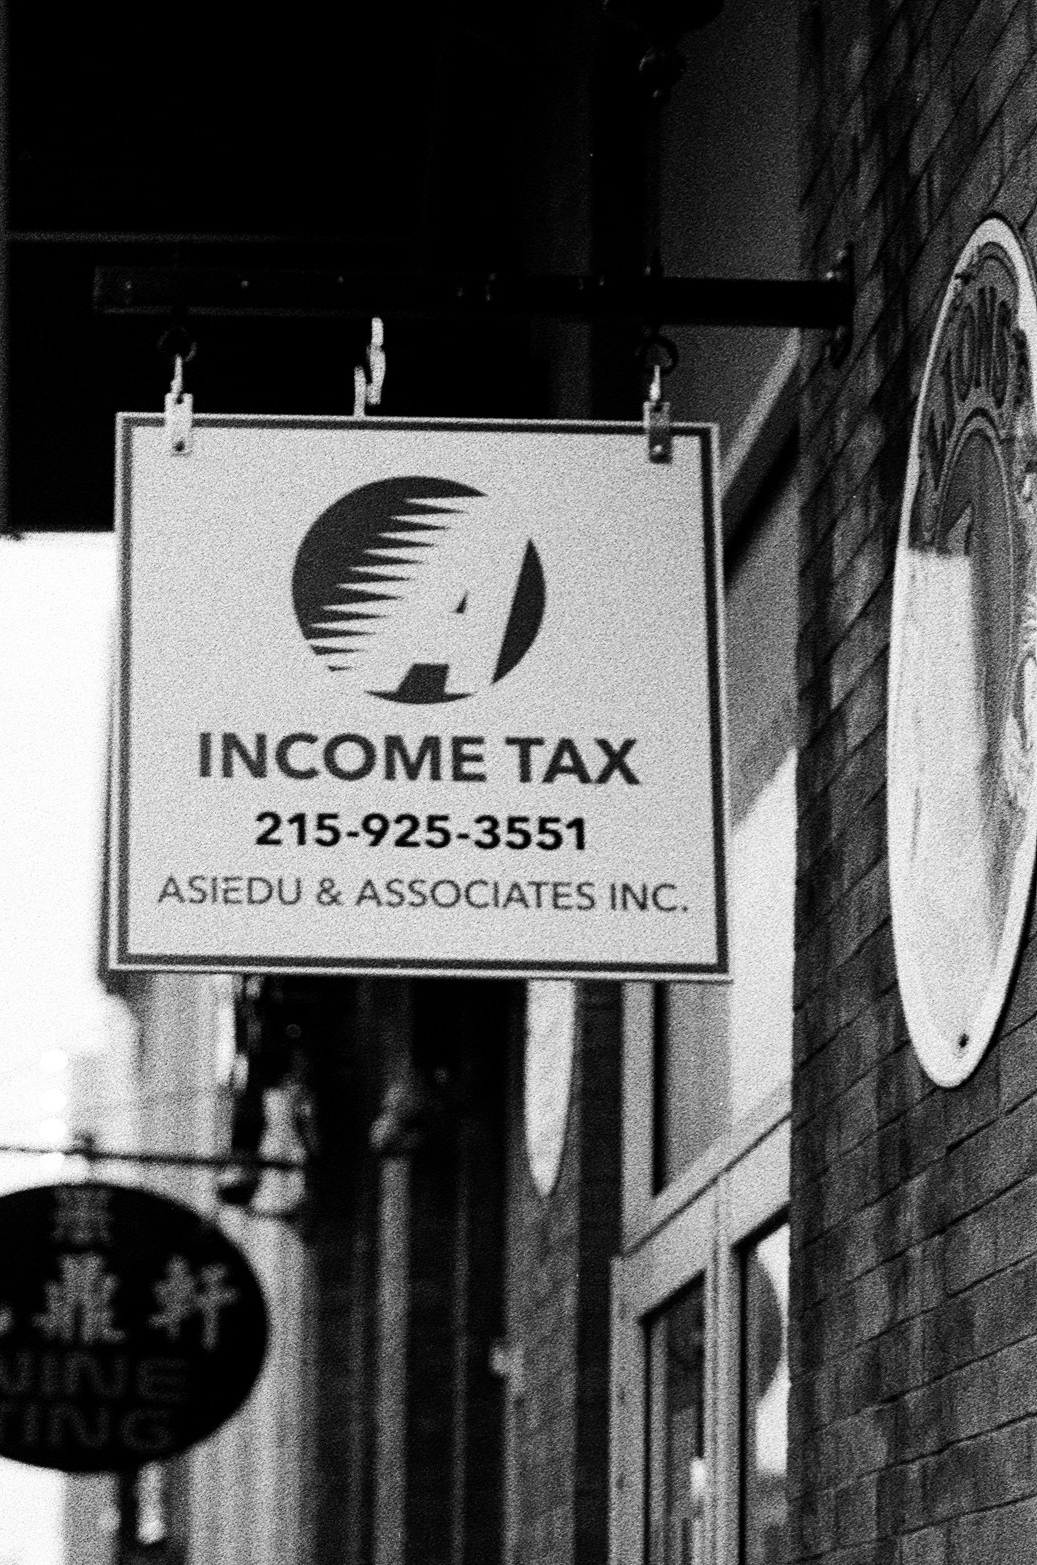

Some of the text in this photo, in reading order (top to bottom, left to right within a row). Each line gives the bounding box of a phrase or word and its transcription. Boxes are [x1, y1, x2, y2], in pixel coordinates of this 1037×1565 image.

[198, 731, 641, 785] INCOME TAX
[255, 812, 587, 851] 215-925-3551
[157, 876, 690, 914] ASIEDU & ASSOCIATES INC.
